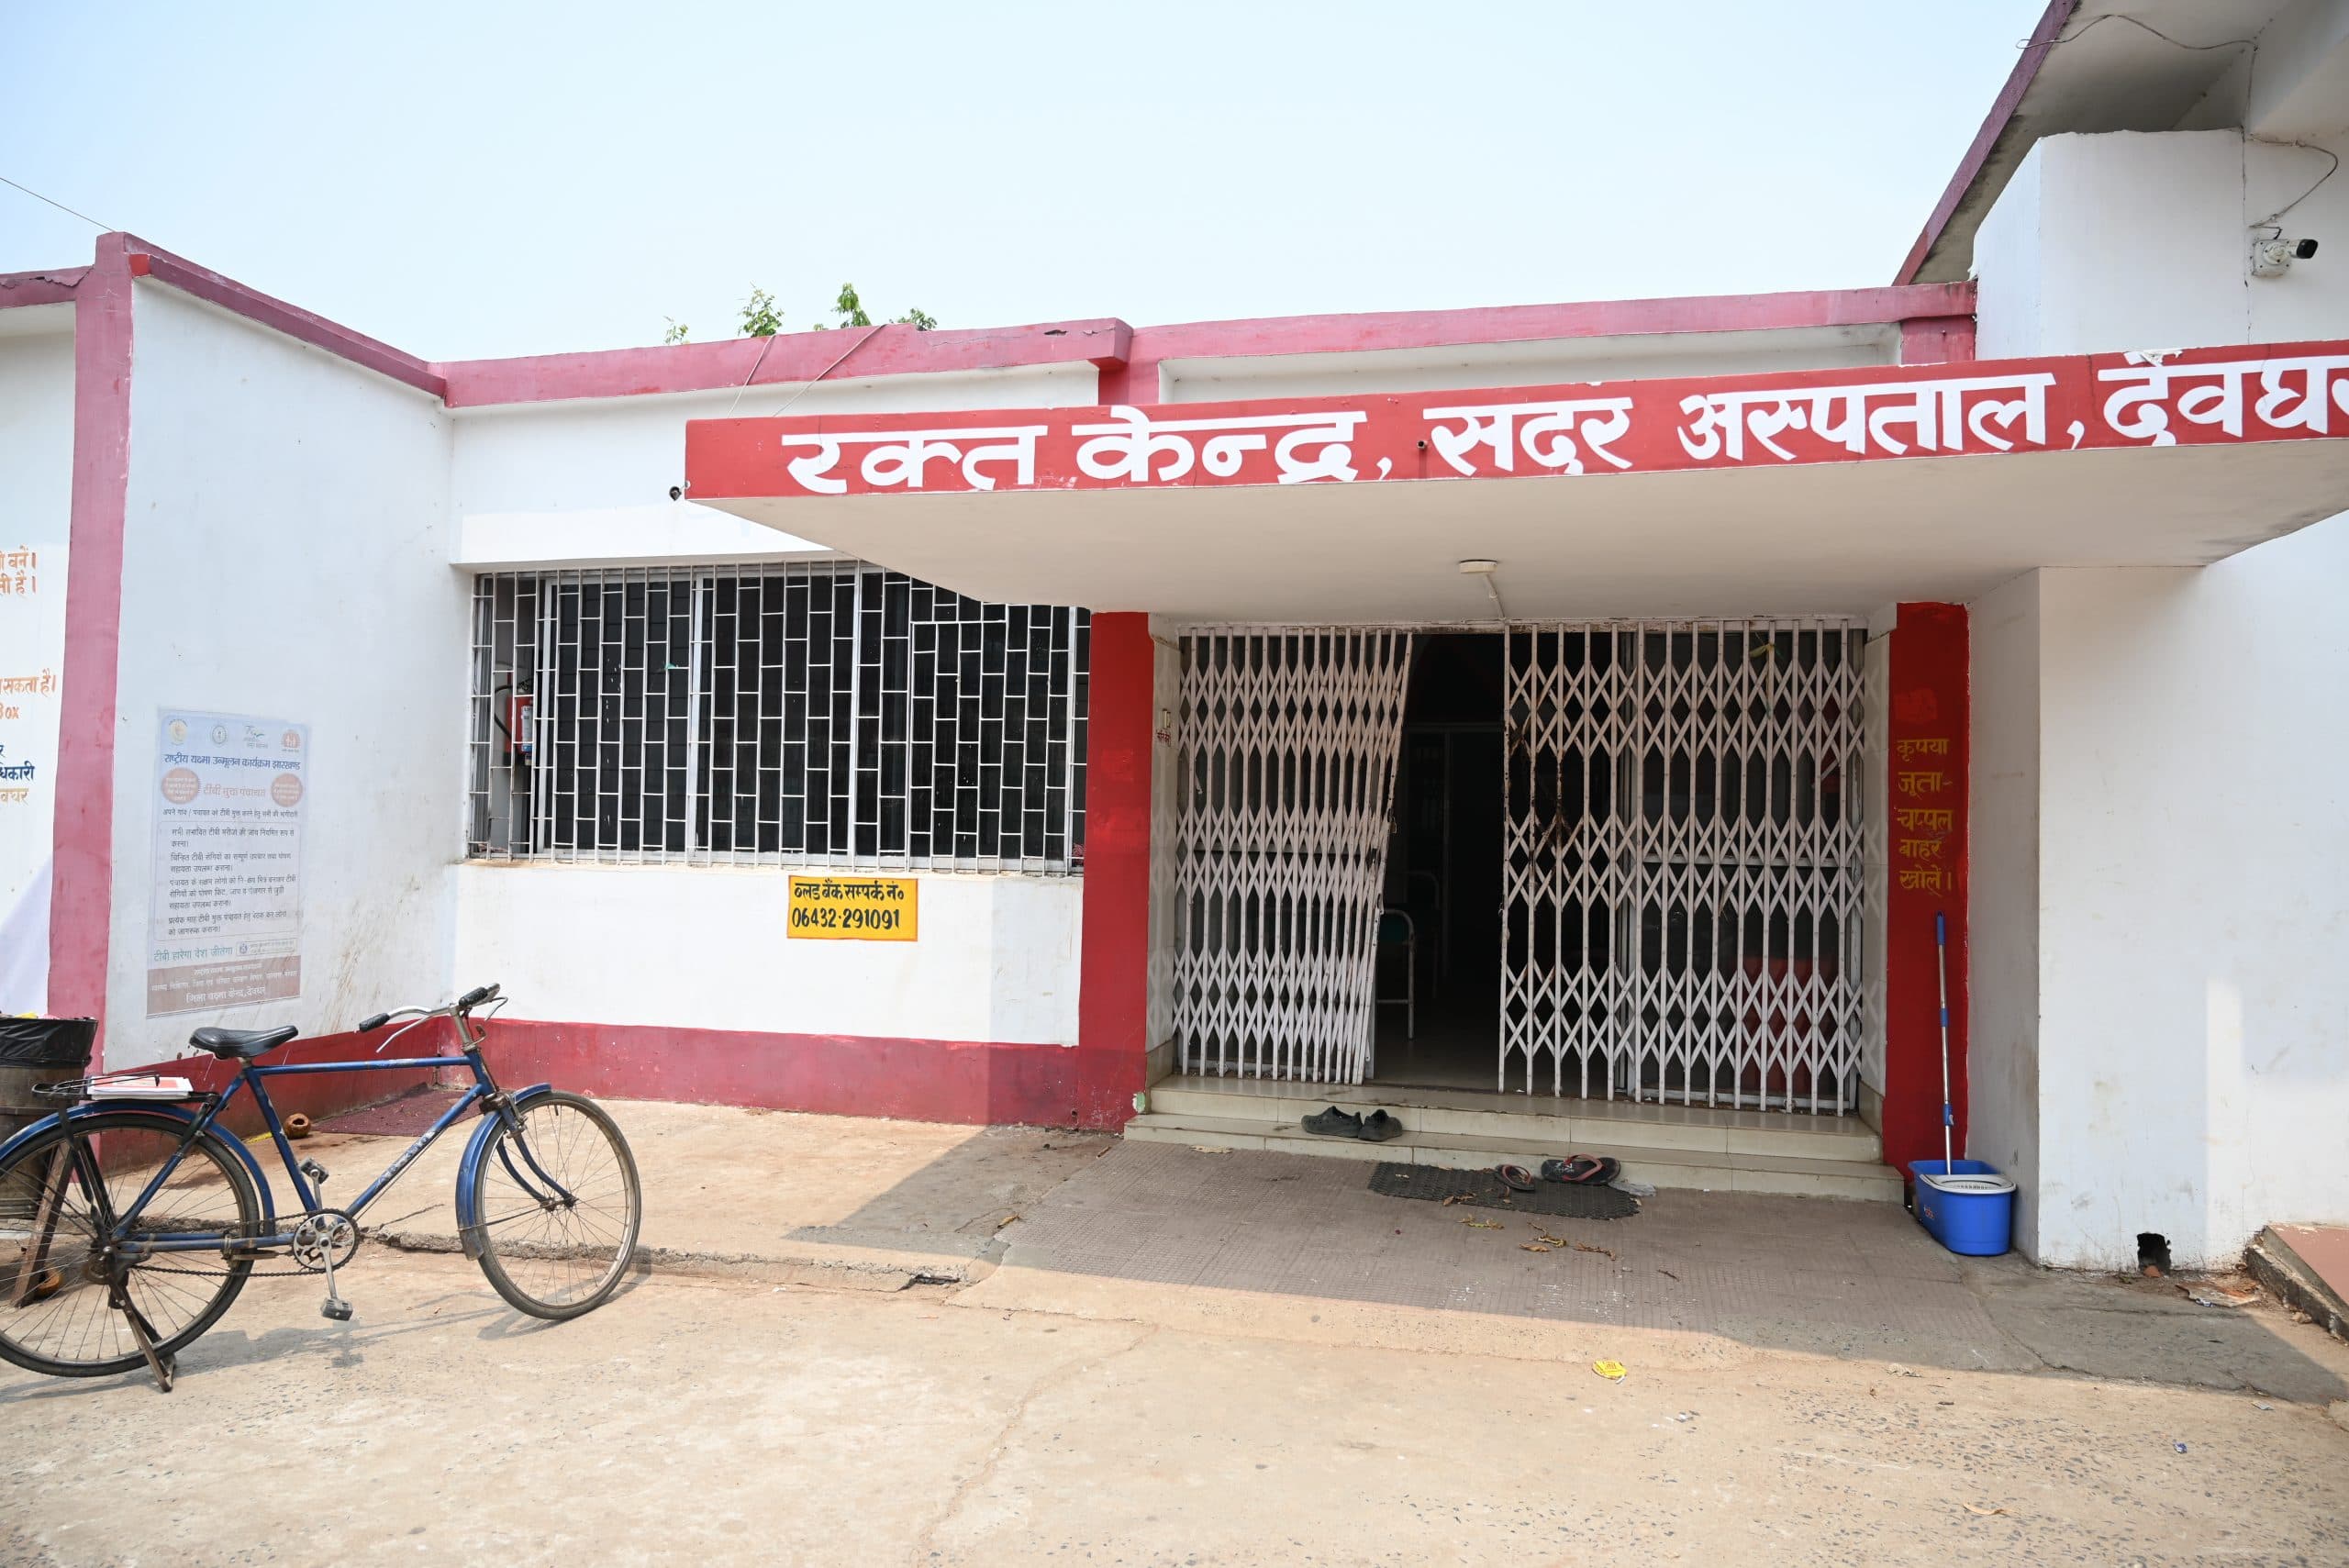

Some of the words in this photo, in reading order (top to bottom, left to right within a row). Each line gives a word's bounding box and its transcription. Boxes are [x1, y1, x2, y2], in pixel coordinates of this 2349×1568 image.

[782, 426, 1048, 494] रक्त
[1423, 397, 1633, 476] सदर
[164, 752, 188, 764] राष्ट्रीय
[213, 757, 239, 769] उन्मूलन
[242, 757, 270, 768] कार्यक्रम
[1898, 739, 1949, 762] कृपया
[1897, 809, 1954, 831] चप्पल
